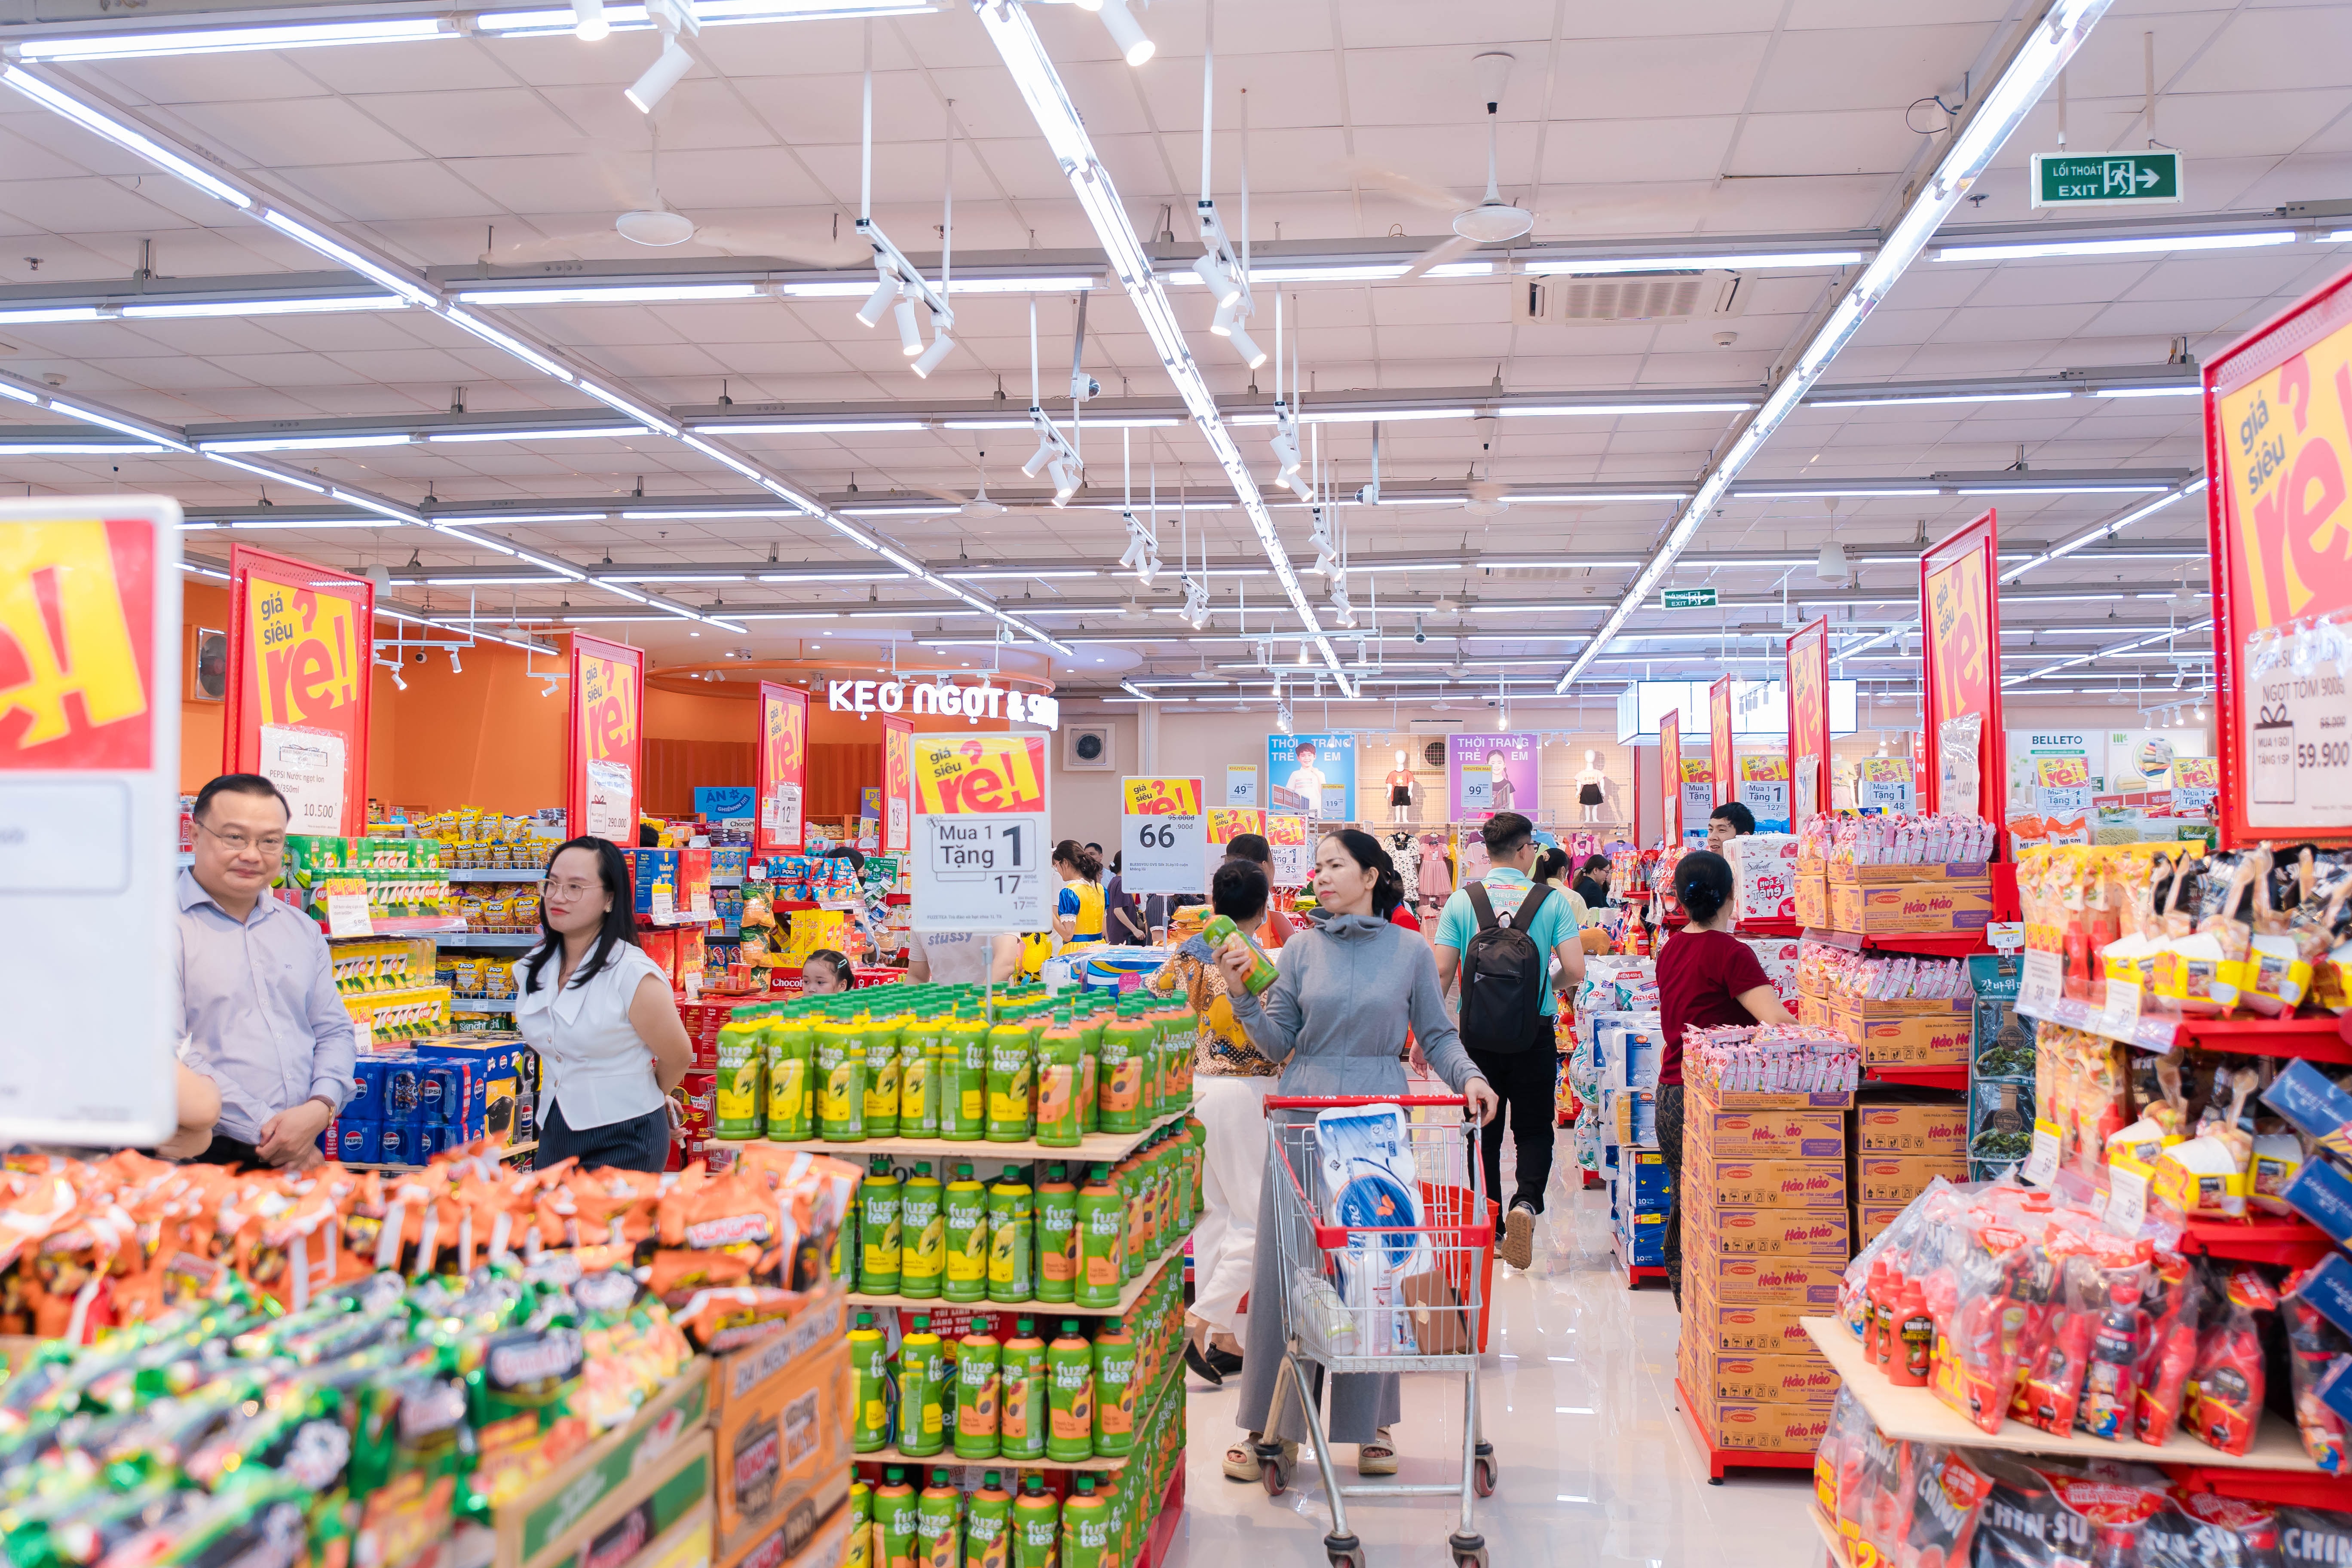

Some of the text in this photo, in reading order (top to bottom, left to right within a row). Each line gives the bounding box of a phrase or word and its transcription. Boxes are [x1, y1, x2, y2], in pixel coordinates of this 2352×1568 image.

[2053, 162, 2103, 177] LỐI THOÁT
[2058, 184, 2098, 196] EXIT
[2241, 389, 2269, 456] giá
[2248, 433, 2285, 495] siêu
[1936, 577, 1948, 616] giá
[261, 592, 284, 620] giá
[1940, 605, 1954, 640] siêu
[264, 622, 294, 645] siêu
[586, 663, 597, 685] giá
[588, 684, 602, 702] siêu
[2263, 682, 2290, 706] NGỌT
[2295, 677, 2318, 700] TÔM
[829, 680, 903, 720] KẸO
[913, 684, 1004, 724] NGỌT
[1271, 738, 1298, 748] THỜI
[1458, 738, 1529, 748] THỜI TRANG
[2032, 736, 2082, 744] BELLETO
[2258, 737, 2272, 748] MUA
[930, 747, 951, 765] giá
[1271, 750, 1341, 761] TRẺ EM
[1458, 750, 1528, 761] TRẺ EM
[2297, 741, 2349, 769] 59.900
[934, 761, 961, 778] siêu
[2258, 754, 2289, 771] TẶNG SP
[270, 770, 285, 779] PEPSI
[287, 772, 302, 780] Nước
[303, 775, 315, 783] ngọt
[1133, 783, 1146, 794] giá
[1234, 786, 1246, 794] 49
[1469, 786, 1481, 795] 99
[1773, 787, 1781, 802] 1
[1873, 791, 1894, 800] Tặng
[706, 790, 726, 803] ĂN
[1136, 792, 1152, 802] siêu
[1689, 793, 1709, 801] Tặng
[1749, 793, 1770, 801] Tặng
[2049, 796, 2070, 805] Tặng
[2184, 797, 2205, 805] Tặng
[304, 803, 333, 818] 10.500
[782, 806, 790, 823] 12
[608, 818, 626, 827] 290.000
[1216, 818, 1228, 826] siêu
[940, 825, 992, 839] Mua 1
[1140, 824, 1175, 848] 66
[1003, 825, 1021, 866] 1
[940, 845, 994, 868] Tặng
[995, 875, 1020, 894] 17
[1752, 885, 1781, 900] Tặng
[1014, 901, 1025, 910] 17
[1903, 895, 1953, 914] Hảo Hảo
[772, 978, 803, 987] ChocoP
[1632, 993, 1658, 1001] ARIEL
[1931, 1033, 1954, 1049] Hảo
[993, 1045, 1028, 1061] fuze
[994, 1060, 1020, 1072] tea
[475, 1085, 484, 1093] PEPSI
[327, 1130, 337, 1138] 6
[1781, 1175, 1829, 1192] Hảo Hảo
[867, 1197, 900, 1213] fuze
[903, 1197, 937, 1214] fuze
[867, 1213, 892, 1225] tea
[903, 1213, 928, 1227] tea
[1785, 1228, 1807, 1241] Hảo
[962, 1357, 994, 1374] fuze
[1057, 1361, 1090, 1378] fuze
[962, 1373, 985, 1385] tea
[1057, 1375, 1083, 1388] tea
[1980, 1496, 2088, 1545] CHIN-SU
